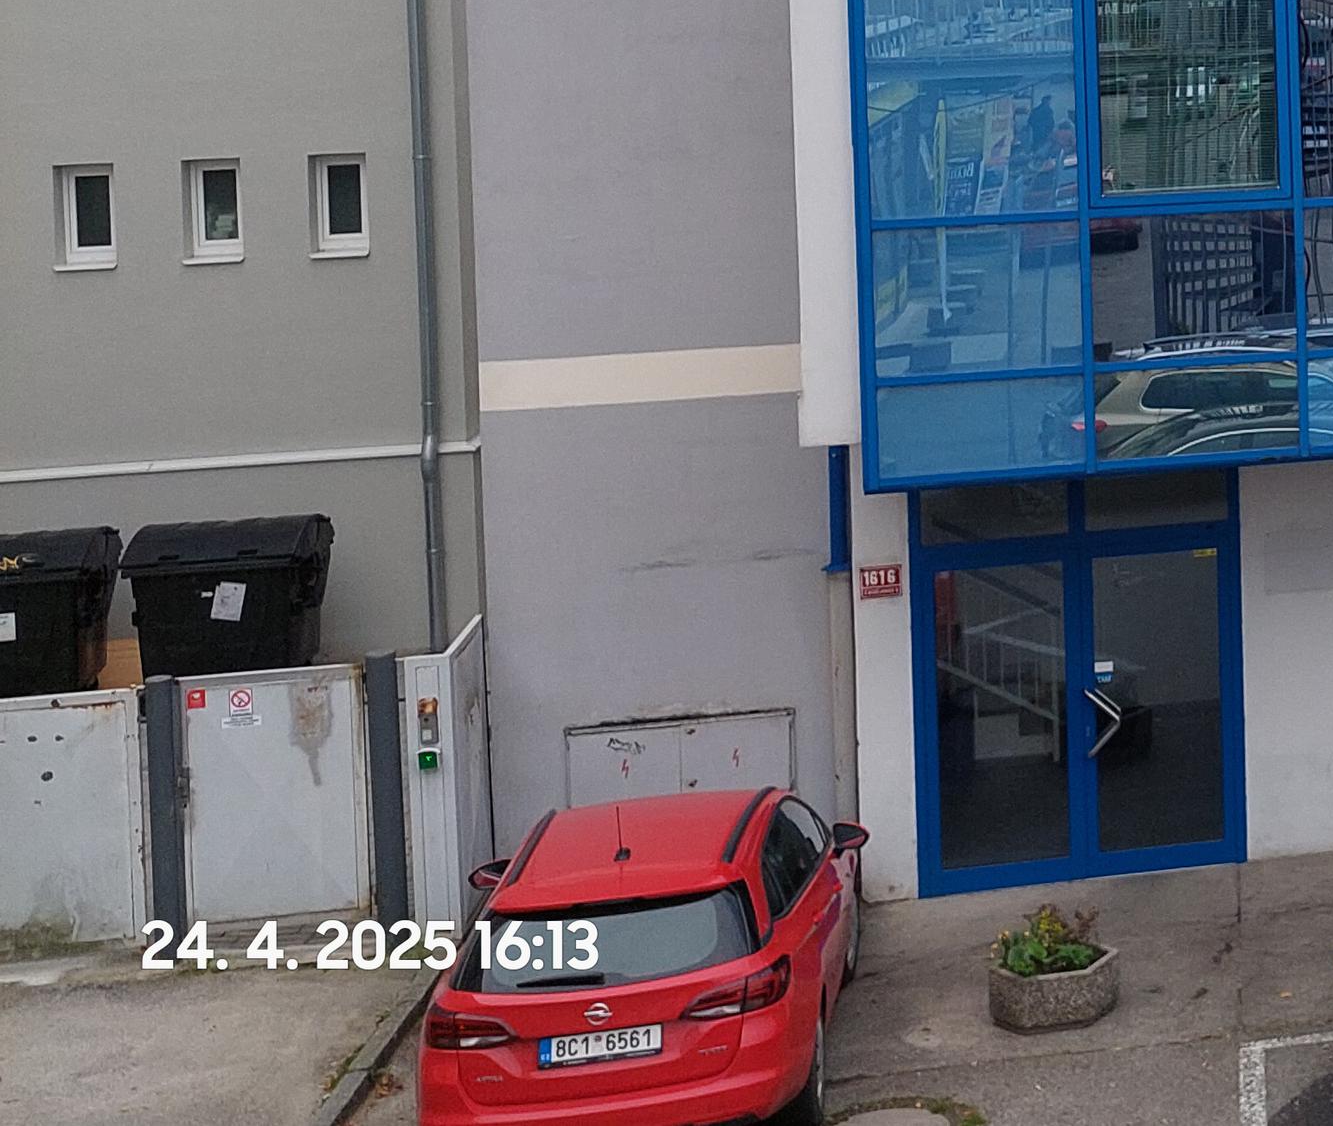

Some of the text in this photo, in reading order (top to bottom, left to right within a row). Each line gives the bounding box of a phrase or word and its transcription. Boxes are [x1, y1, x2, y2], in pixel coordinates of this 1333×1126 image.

[863, 569, 896, 586] 1616
[556, 1028, 652, 1058] 8C1 6561
